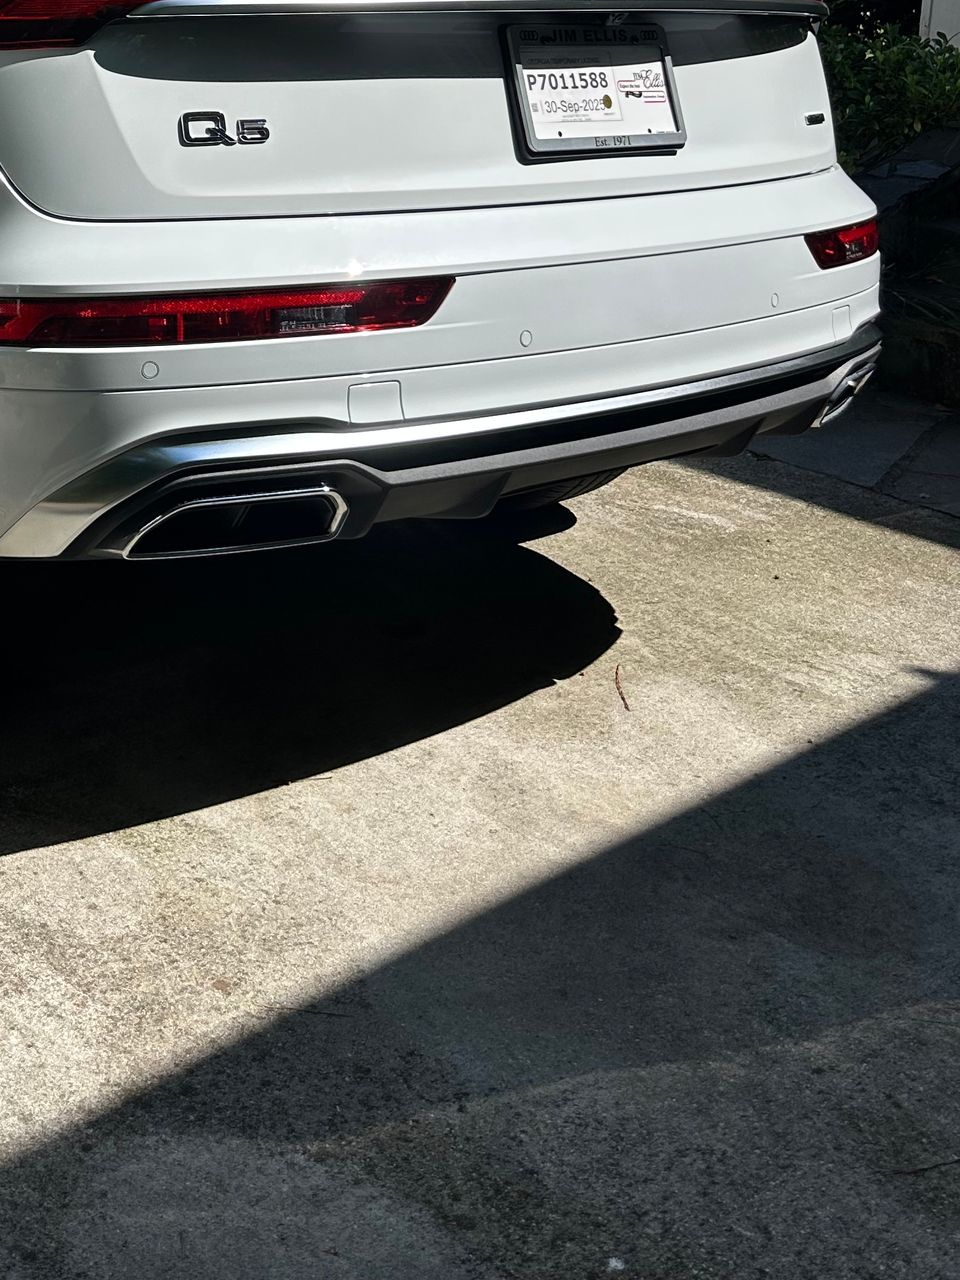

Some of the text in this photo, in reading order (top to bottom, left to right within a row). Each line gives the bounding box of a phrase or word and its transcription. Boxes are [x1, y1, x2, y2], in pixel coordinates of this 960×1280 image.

[552, 29, 627, 42] JIM ELLIS
[527, 72, 608, 90] P7011588
[545, 99, 606, 113] 30-Sep-2025
[178, 111, 270, 147] Q5
[594, 136, 631, 147] Est. 1971
